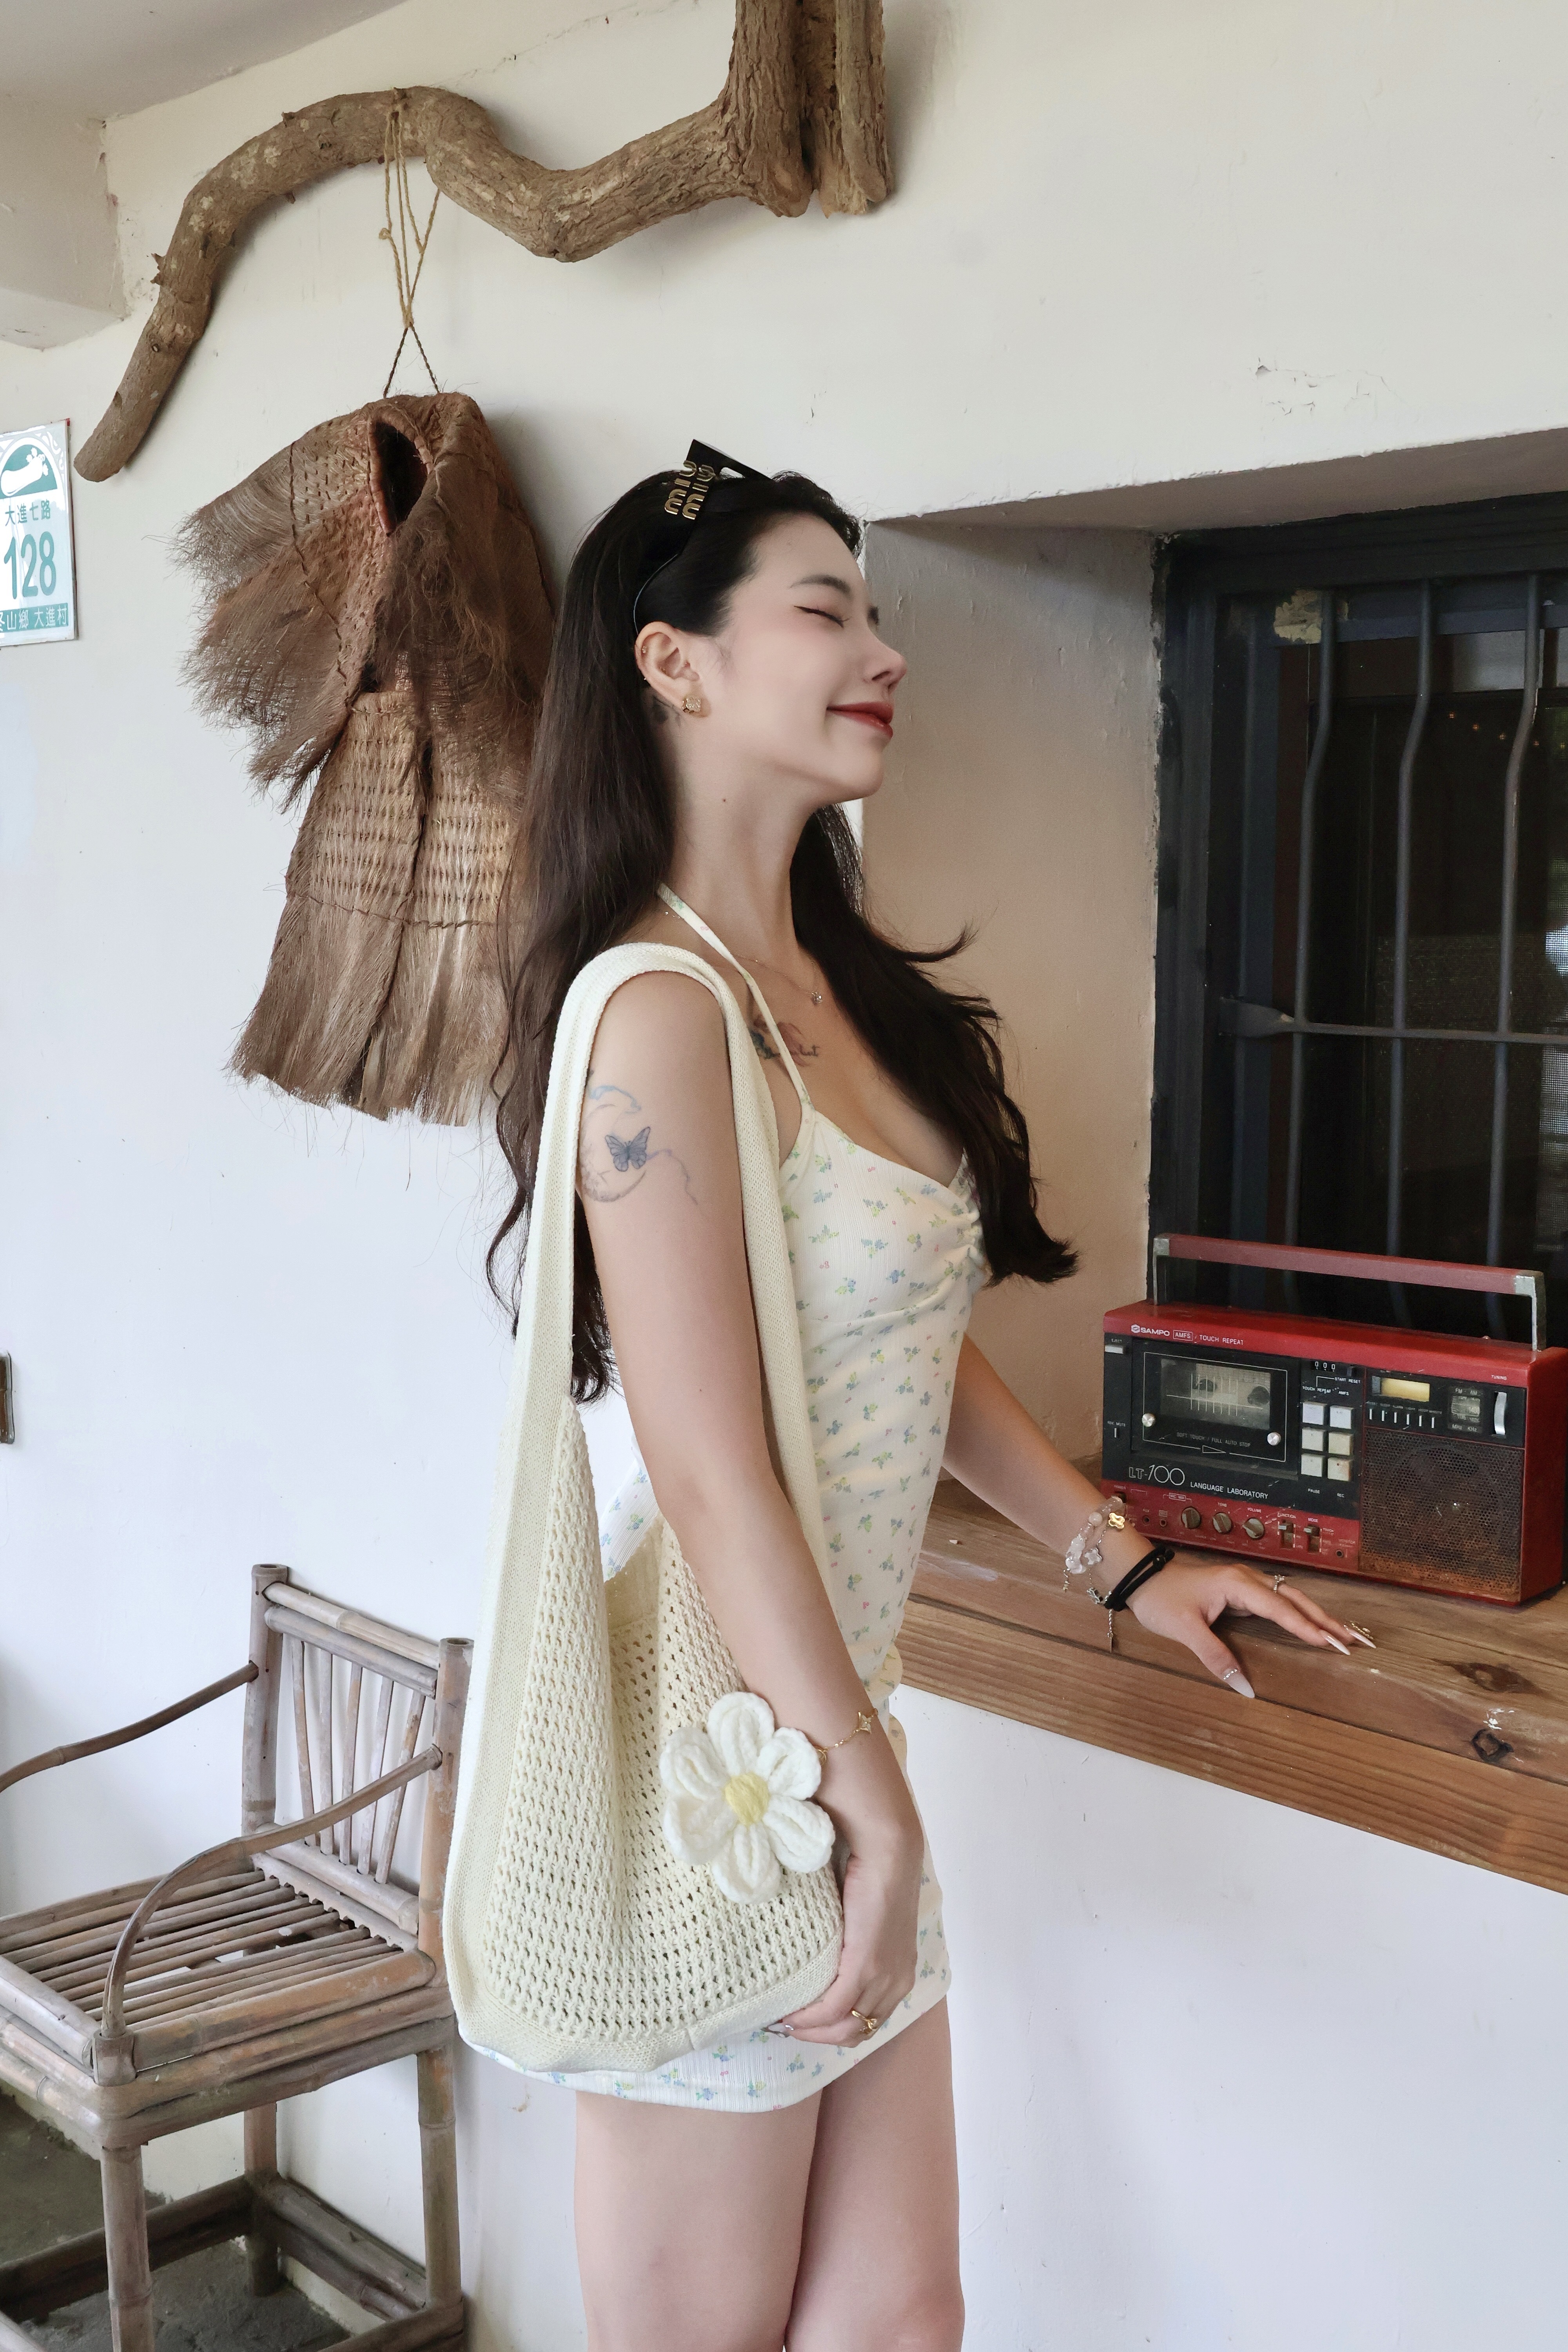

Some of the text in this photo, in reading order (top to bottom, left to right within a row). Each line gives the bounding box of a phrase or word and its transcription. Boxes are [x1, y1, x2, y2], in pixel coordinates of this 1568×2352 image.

[5, 499, 51, 527] 大進七路
[4, 531, 56, 599] 128
[34, 606, 68, 628] 大進村
[1140, 1327, 1170, 1336] SAMPO
[1200, 1334, 1219, 1343] TOUCH
[1129, 1465, 1185, 1486] LT-100
[1190, 1481, 1269, 1499] LANGUAGE LABORATORY
